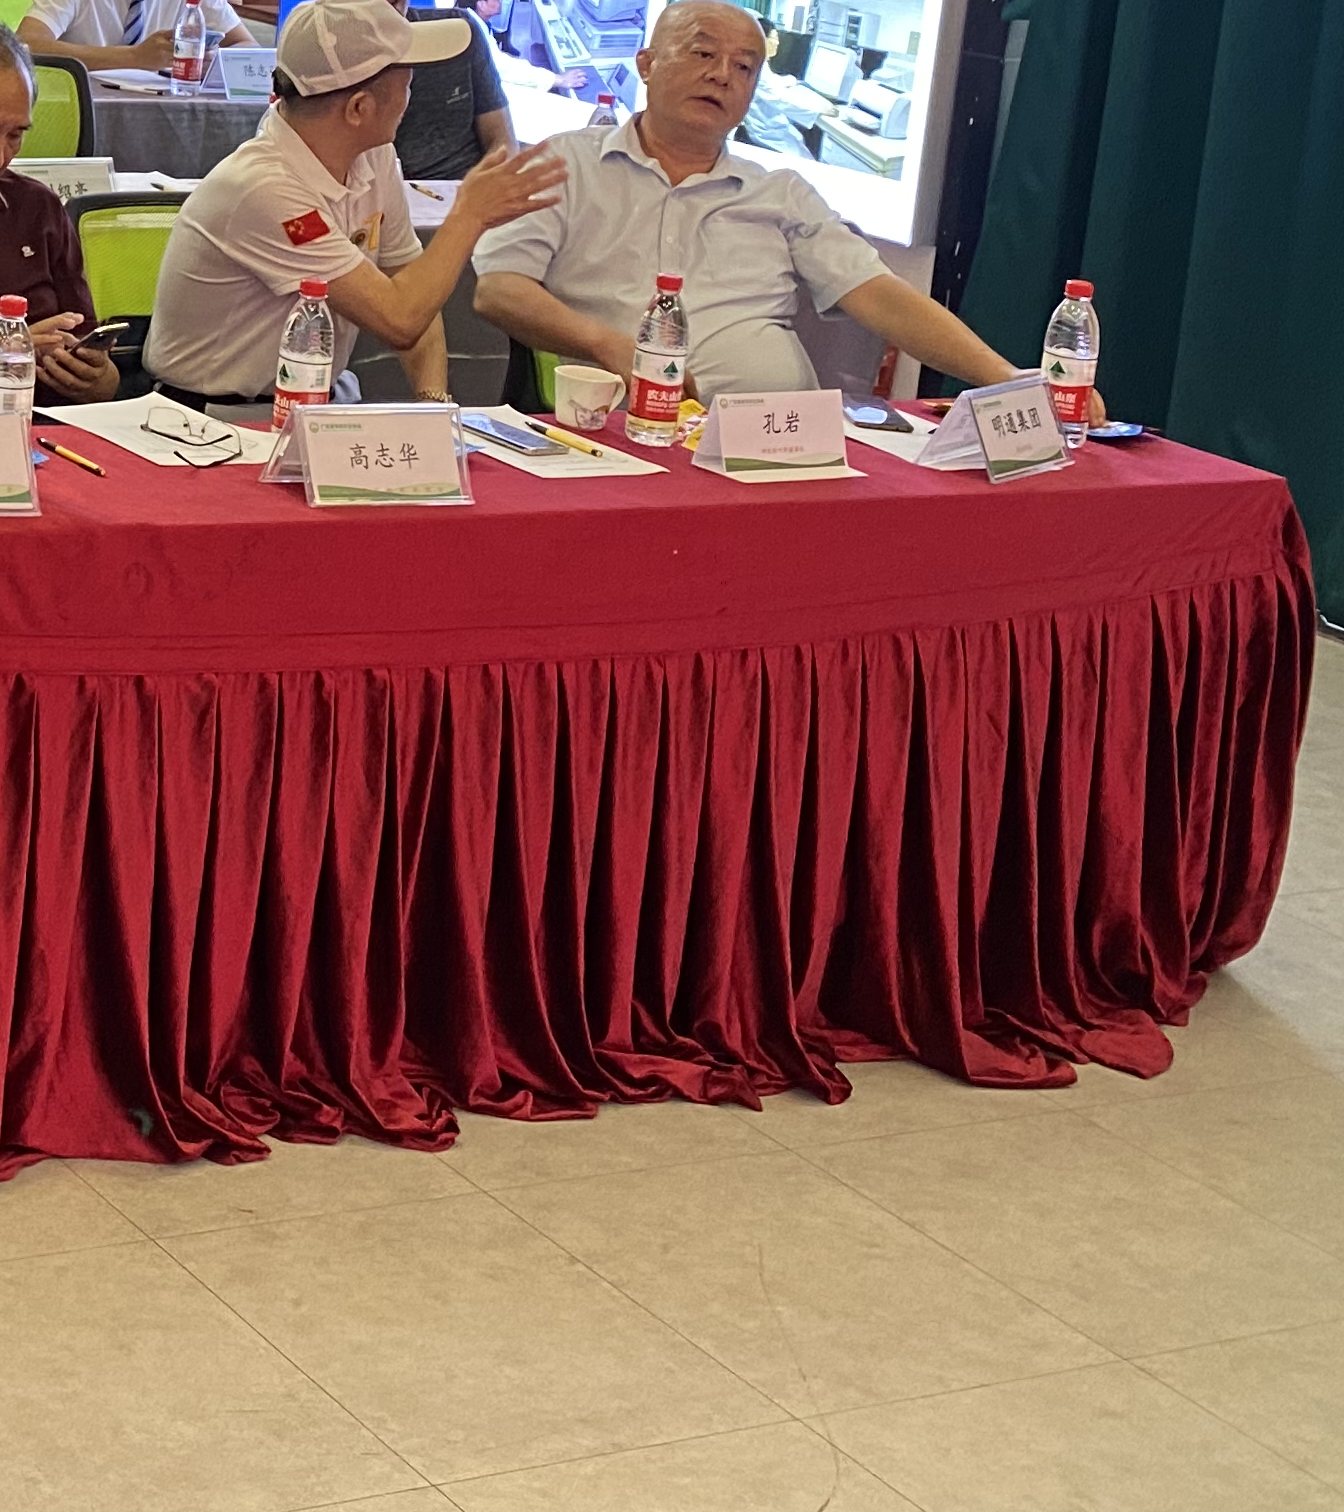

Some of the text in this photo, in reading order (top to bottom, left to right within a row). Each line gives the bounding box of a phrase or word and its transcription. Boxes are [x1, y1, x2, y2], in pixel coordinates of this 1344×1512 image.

[762, 409, 801, 435] 孔岩
[348, 442, 421, 471] 高志华
